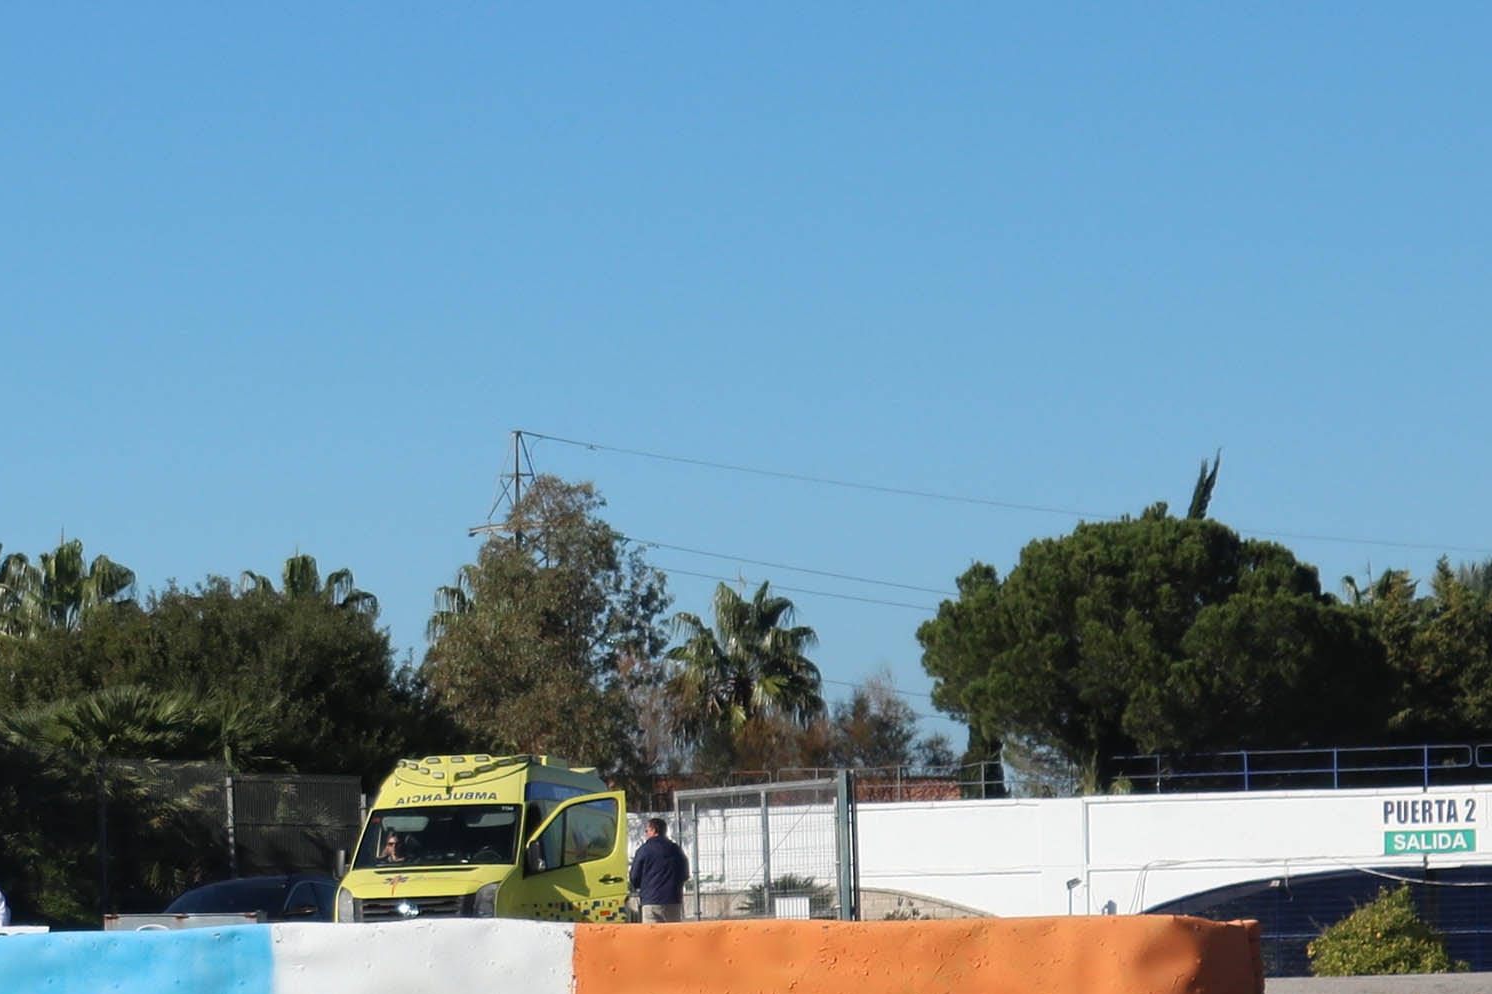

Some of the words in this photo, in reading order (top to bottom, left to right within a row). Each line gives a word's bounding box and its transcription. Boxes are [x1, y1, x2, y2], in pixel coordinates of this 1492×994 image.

[1383, 799, 1459, 824] PUERTA
[1465, 798, 1476, 822] 2
[1393, 832, 1467, 850] SALIDA
